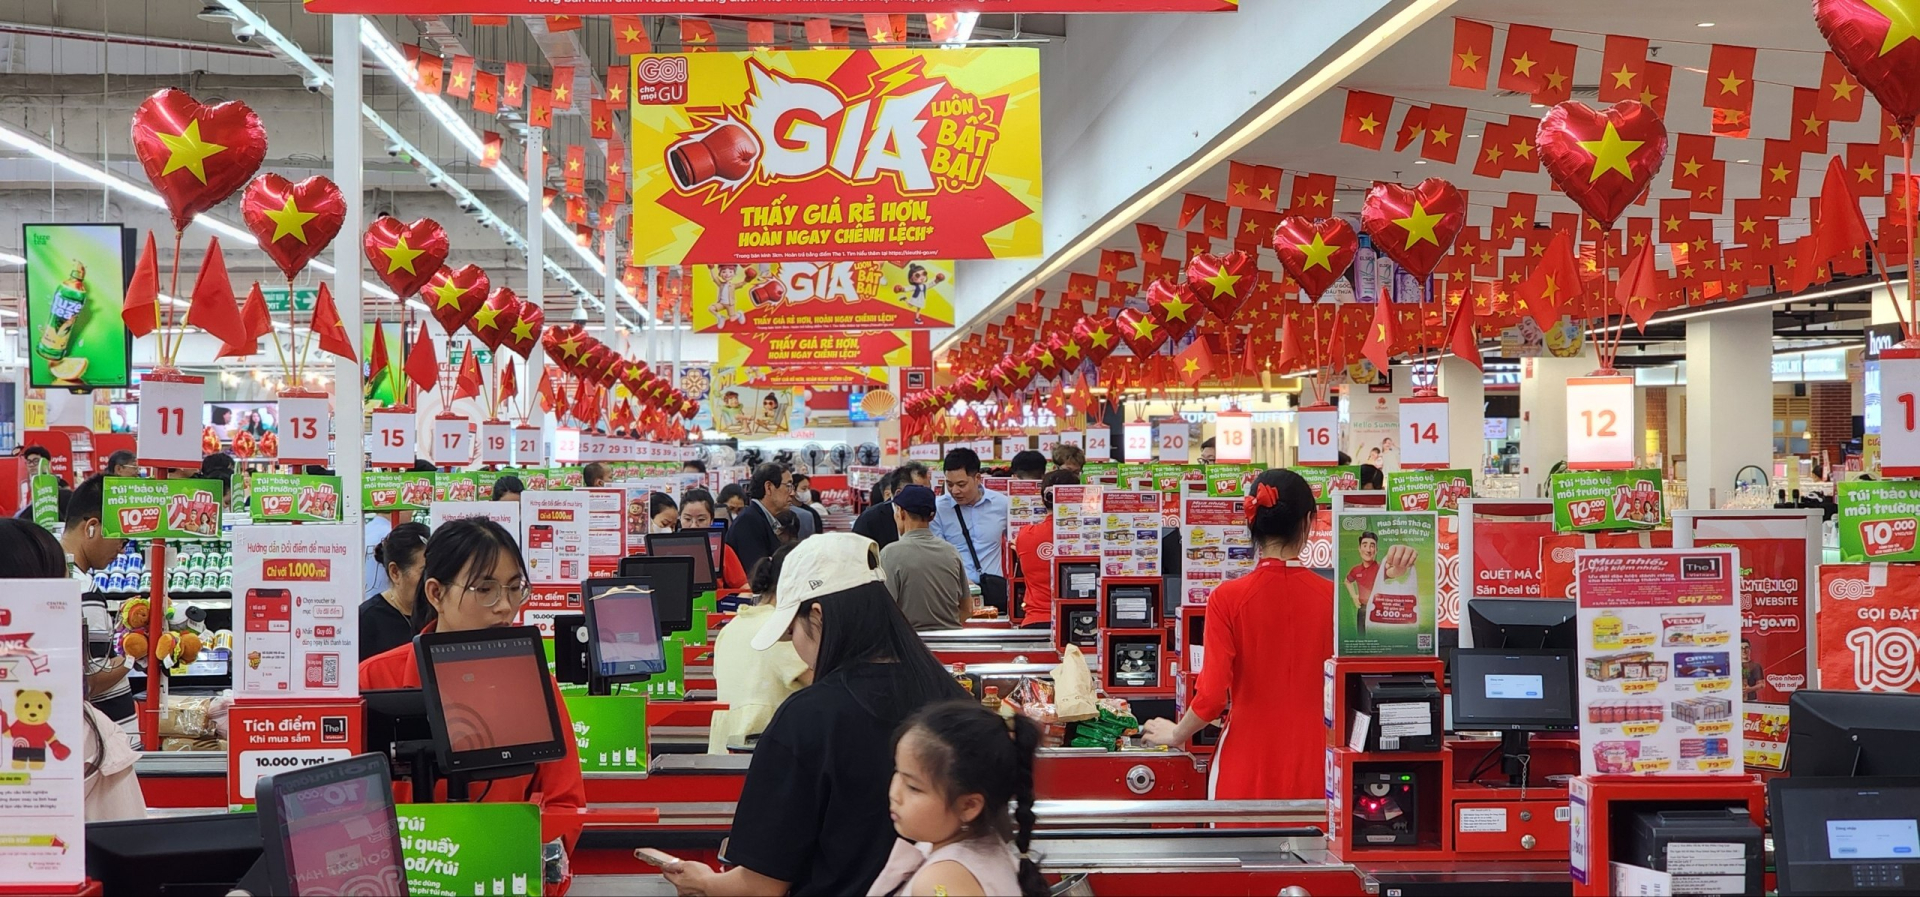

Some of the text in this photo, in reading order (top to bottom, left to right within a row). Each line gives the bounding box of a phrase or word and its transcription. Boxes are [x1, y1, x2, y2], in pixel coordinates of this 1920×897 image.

[639, 57, 688, 83] GO!
[640, 86, 655, 94] cho
[640, 86, 683, 101] mọi GU
[931, 92, 973, 118] LUÔN
[936, 115, 994, 158] BẤT
[929, 152, 983, 189] BẠI
[740, 194, 932, 227] THẤY GIÁ RẺ HƠN,
[738, 226, 782, 247] HOÀN
[786, 228, 831, 246] NGAY
[834, 223, 885, 244] CHÊNH
[54, 292, 82, 314] fuze
[52, 303, 76, 320] tea
[769, 334, 797, 350] THẤY
[799, 335, 818, 349] GIÁ
[1897, 392, 1917, 431] 1
[157, 406, 185, 436] 11
[1580, 409, 1617, 438] 12
[290, 417, 318, 440] 13
[1410, 422, 1439, 445] 14
[380, 428, 405, 448] 15
[441, 432, 461, 449] 17
[488, 436, 504, 450] 19
[1089, 437, 1106, 449] 24
[1128, 437, 1147, 449] 22
[1163, 435, 1184, 448] 20
[1223, 430, 1243, 446] 18
[1306, 427, 1330, 446] 16
[520, 439, 535, 452] 21
[560, 440, 575, 451] 23
[592, 443, 605, 453] 27
[608, 445, 620, 454] 29
[622, 446, 633, 454] 31
[636, 447, 647, 455] 33
[651, 448, 661, 456] 35
[1013, 444, 1026, 452] 30
[1393, 476, 1405, 484] Túi
[1558, 478, 1575, 488] Túi
[1599, 476, 1612, 486] vệ
[110, 485, 127, 494] Túi
[156, 484, 169, 496] vệ
[1557, 489, 1575, 499] môi
[1847, 490, 1871, 502] Túi
[108, 495, 127, 505] môi
[1844, 503, 1871, 517] môi
[1863, 520, 1916, 545] 10.000
[247, 542, 267, 555] Hướng
[268, 540, 280, 553] dẫn
[309, 540, 318, 553] để
[318, 545, 331, 554] mua
[332, 543, 347, 555] hàng
[266, 565, 276, 577] Chỉ
[1479, 567, 1533, 580] QUÉT MÃ
[1476, 583, 1540, 595] Săn Deal tối
[1754, 596, 1799, 606] WEBSITE
[1857, 606, 1919, 623] GỌI ĐẶT
[1741, 615, 1797, 631] hi-go.vn
[1845, 626, 1920, 691] 19
[243, 715, 316, 733] Tích điểm
[249, 731, 311, 743] Khi mua sắm
[256, 756, 299, 767] 10.000
[415, 836, 460, 858] quầy
